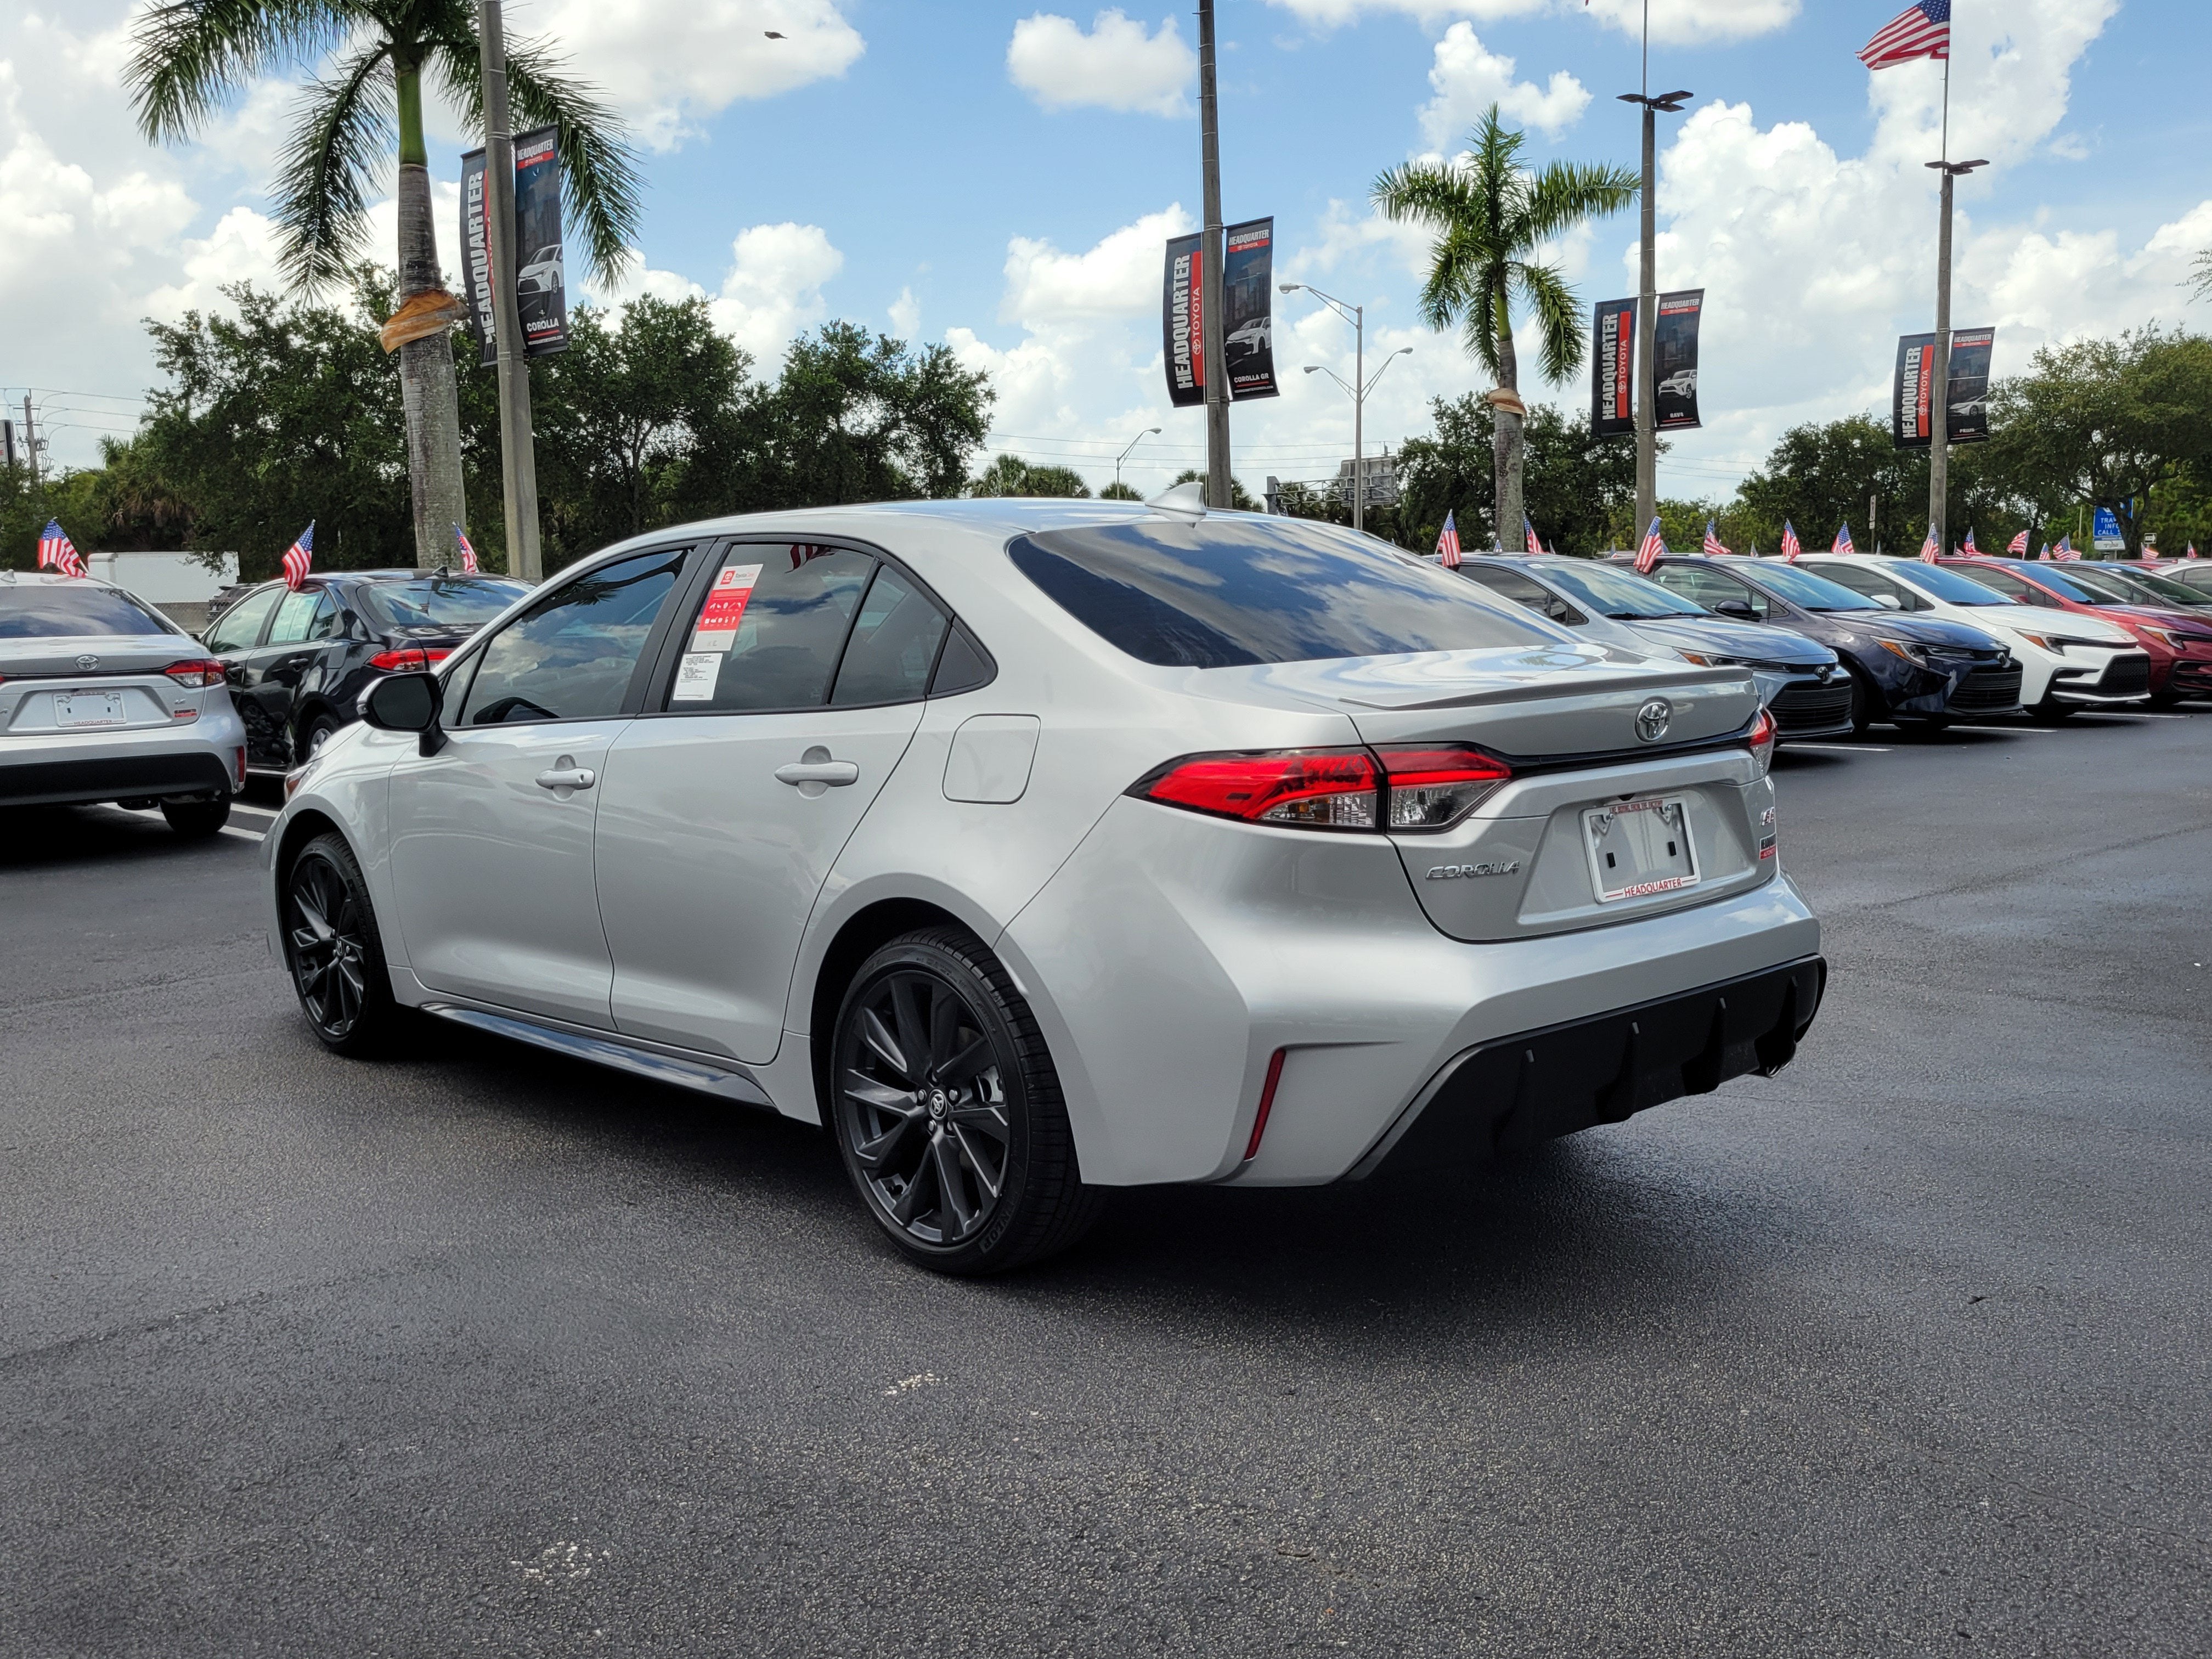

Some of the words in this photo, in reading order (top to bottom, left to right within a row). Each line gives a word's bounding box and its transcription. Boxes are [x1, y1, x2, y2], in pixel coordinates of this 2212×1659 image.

[517, 138, 554, 161] HEADQUARTER
[1229, 229, 1269, 246] HEADQUARTER
[467, 171, 495, 344] HEADQUARTER
[1661, 298, 1700, 310] HEADQUARTER
[526, 317, 560, 332] COROLLA
[1173, 254, 1194, 389] HEADQUARTER
[1954, 334, 1991, 343] HEADQUARTER
[1602, 313, 1618, 420] HEADQUARTER
[1618, 339, 1628, 379] TOYOTA
[1234, 374, 1260, 383] COROLLA
[1920, 369, 1929, 403] TOYOTA
[1901, 346, 1921, 438] HEADQUARTER
[1425, 860, 1520, 879] COROLLA
[1624, 878, 1683, 897] HEADQUARTER
